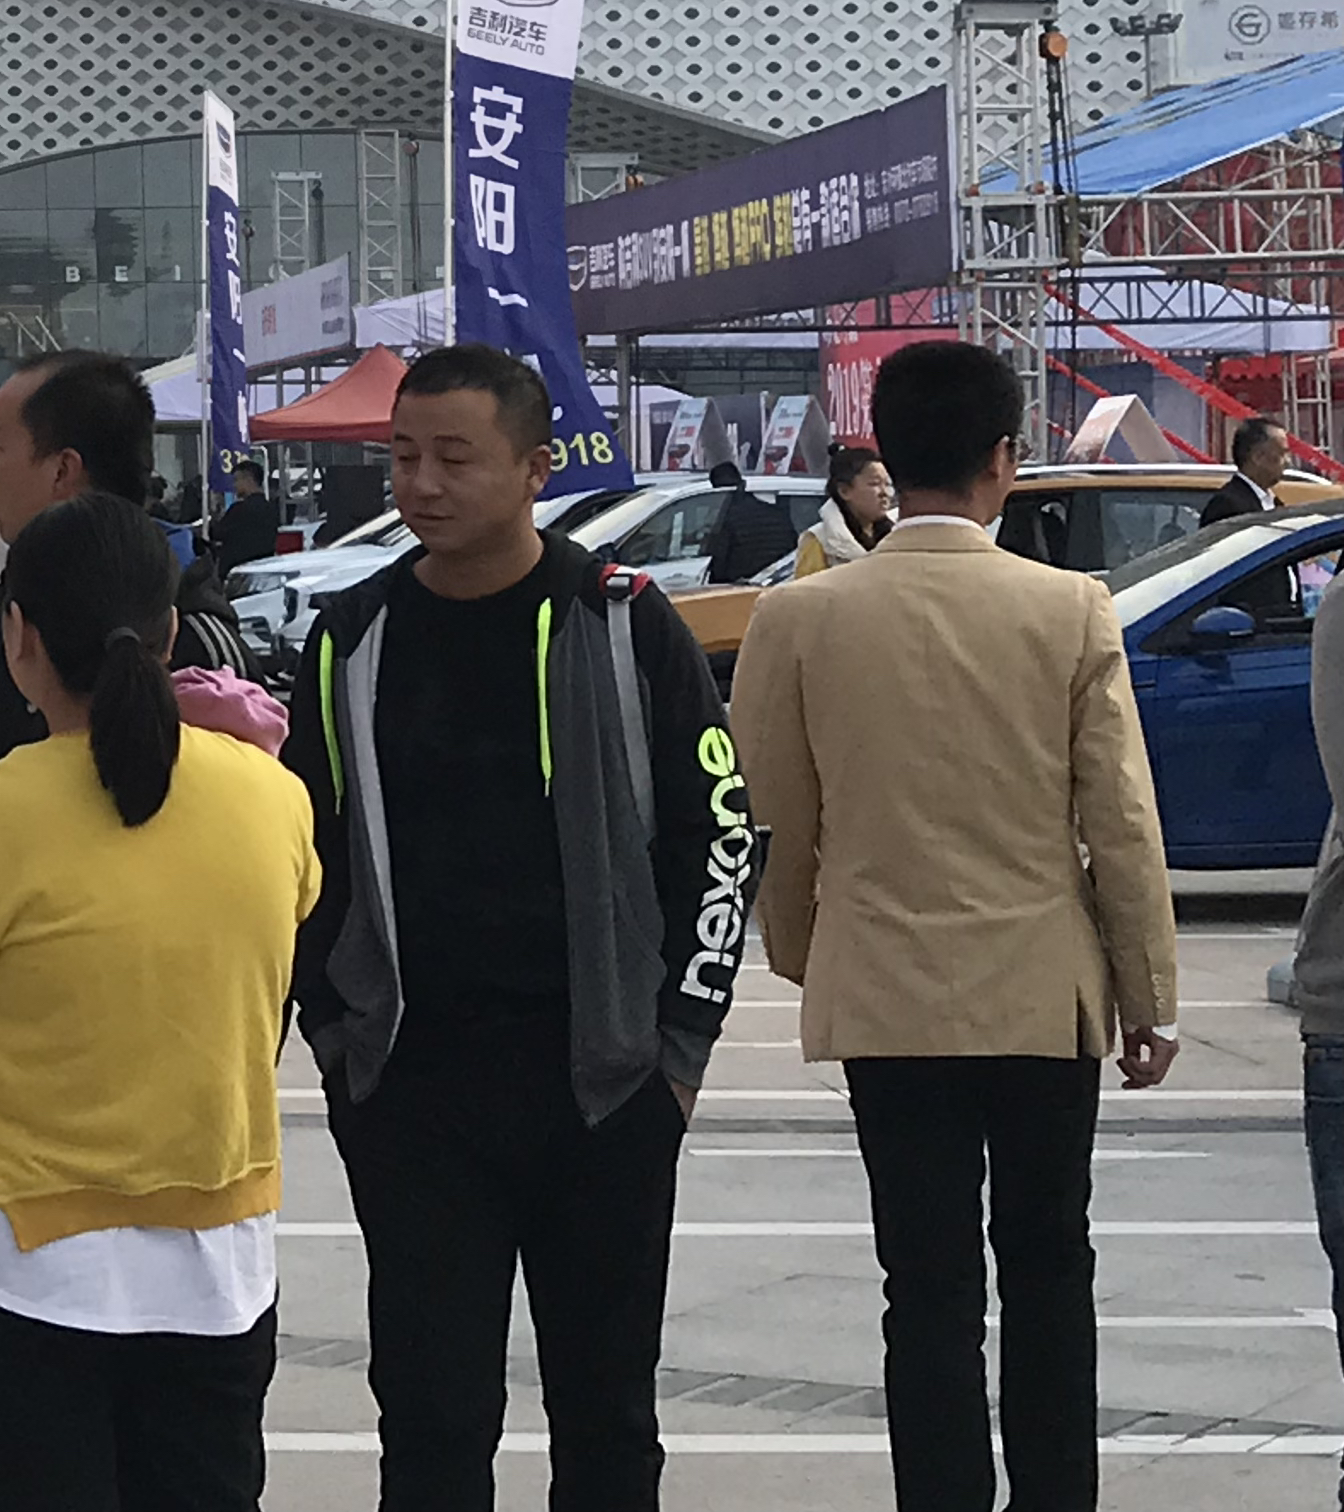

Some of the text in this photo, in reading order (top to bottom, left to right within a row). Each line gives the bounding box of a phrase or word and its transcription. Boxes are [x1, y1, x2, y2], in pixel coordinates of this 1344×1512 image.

[469, 6, 548, 41] 吉利汽车
[511, 38, 545, 56] AUTO
